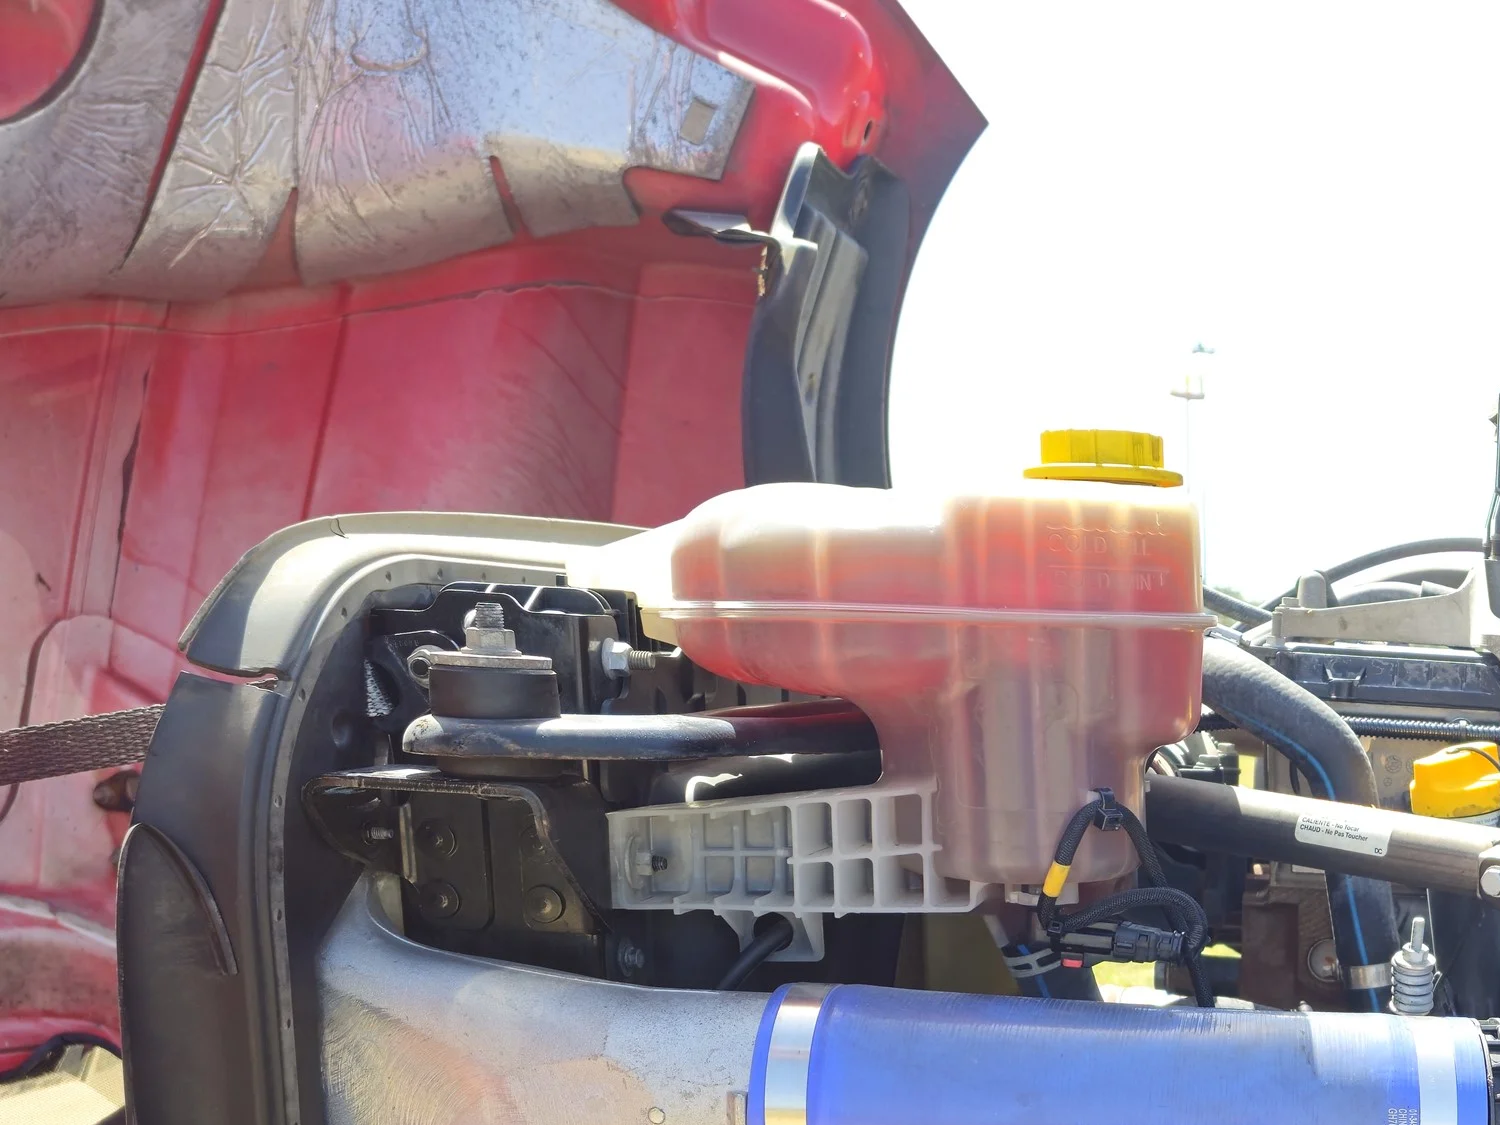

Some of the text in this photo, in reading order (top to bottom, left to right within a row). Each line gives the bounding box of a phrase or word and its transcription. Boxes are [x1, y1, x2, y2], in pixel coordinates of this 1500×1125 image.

[1301, 816, 1330, 827] CALIENTE
[1299, 823, 1321, 833] CHAUD
[1325, 828, 1333, 836] Ne
[1334, 830, 1345, 838] Pas
[1345, 832, 1368, 842] Toucher
